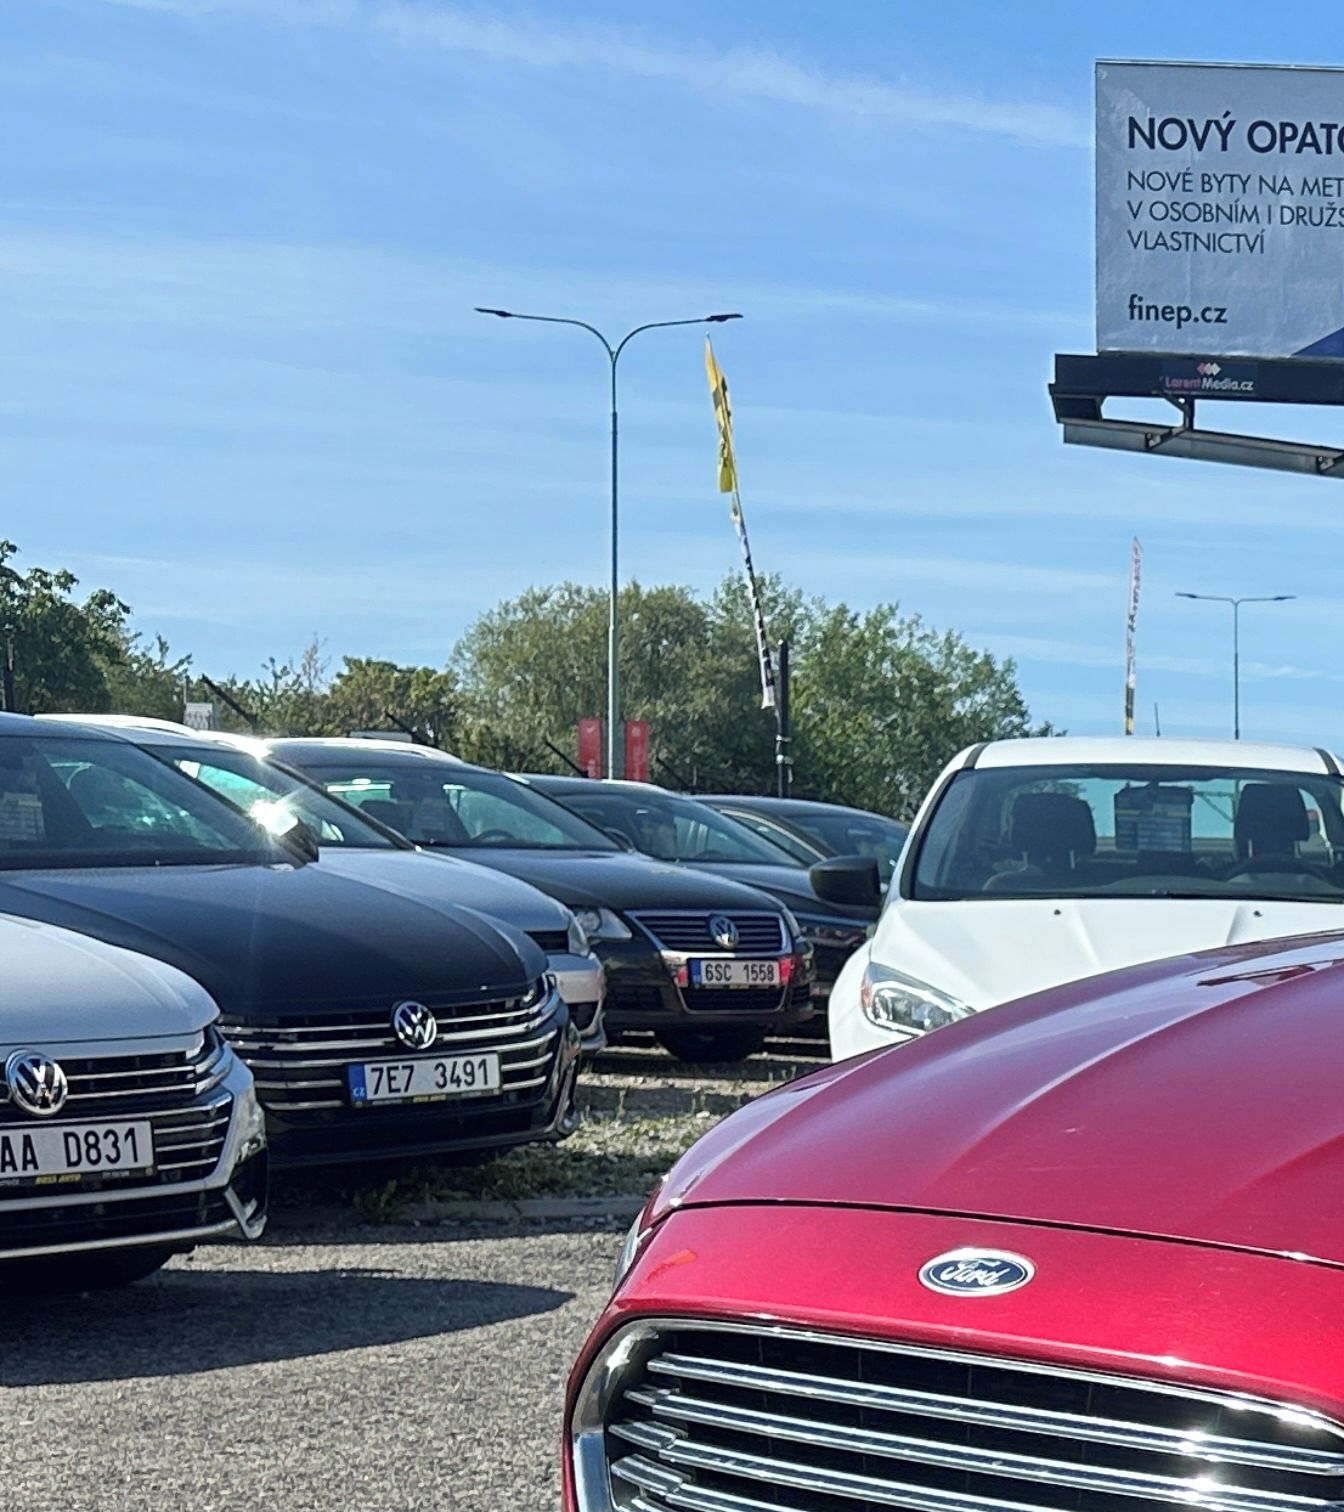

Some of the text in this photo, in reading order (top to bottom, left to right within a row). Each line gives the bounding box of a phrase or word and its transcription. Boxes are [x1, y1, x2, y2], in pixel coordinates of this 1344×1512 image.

[1127, 110, 1237, 152] NOVÝ
[1127, 167, 1194, 193] NOVÉ
[1201, 172, 1251, 194] BYTY
[1258, 175, 1294, 196] NA
[1127, 200, 1143, 220] V
[1149, 198, 1260, 224] OSOBNÍM
[1267, 205, 1272, 225] I
[1127, 228, 1266, 254] VLASTNICTVÍ
[1128, 293, 1228, 330] finep.cz
[370, 1058, 489, 1096] 7E7 3491
[0, 1127, 138, 1173] AA D831
[939, 1258, 1011, 1287] Ford
